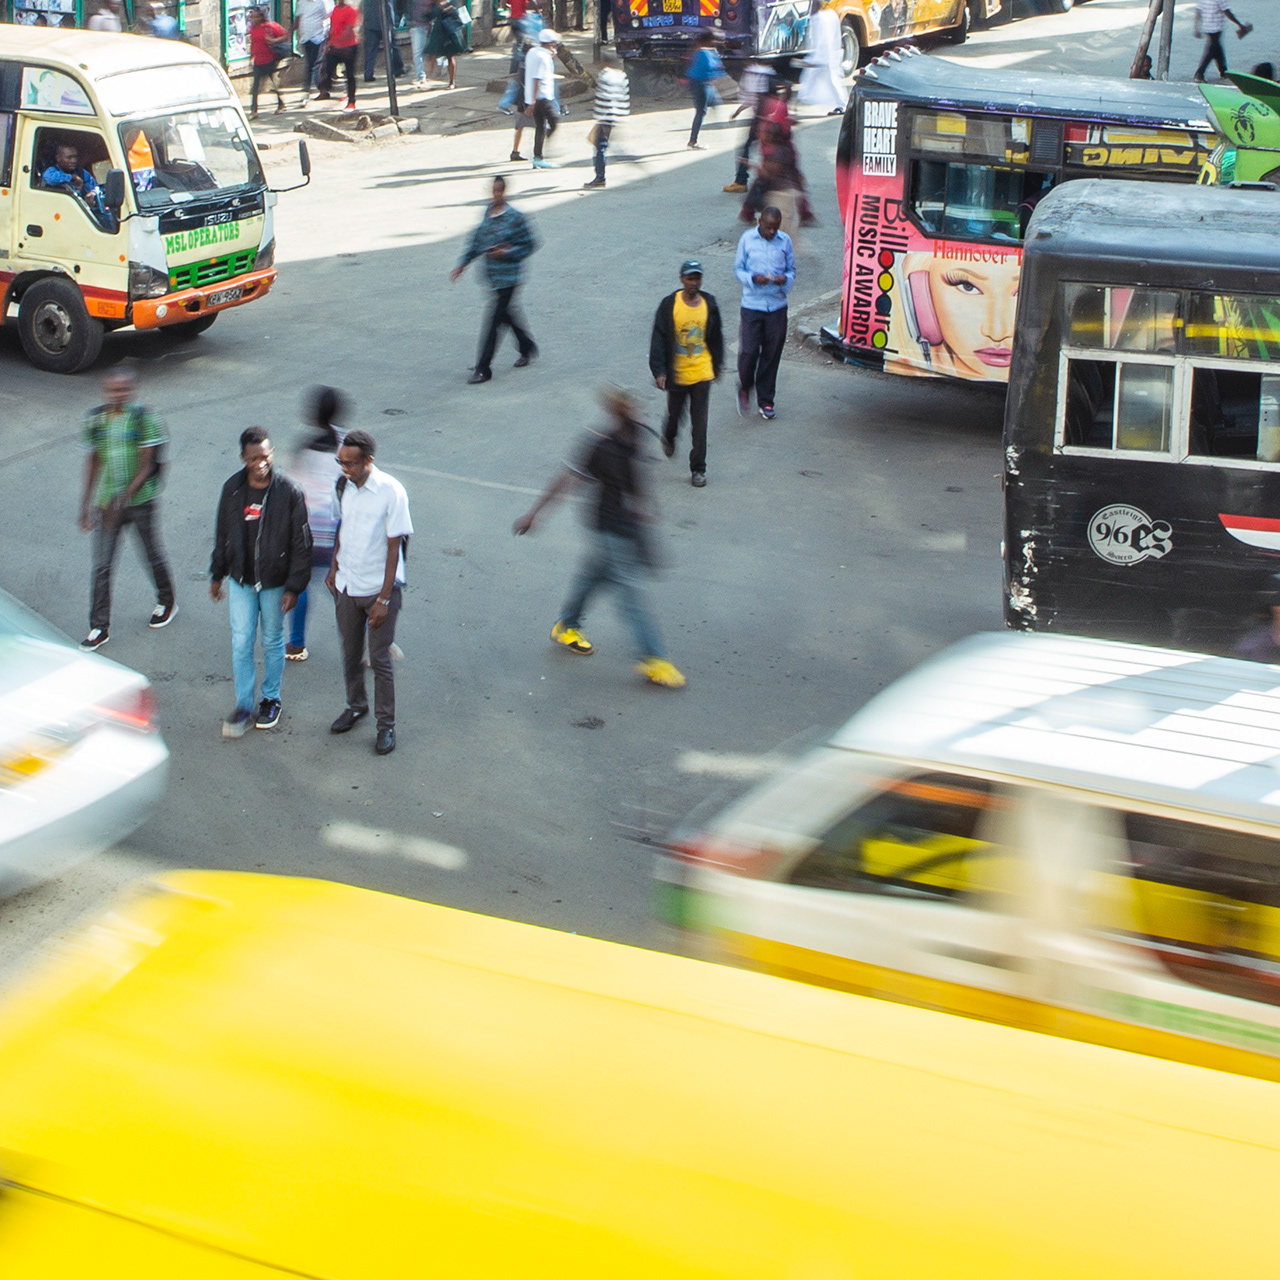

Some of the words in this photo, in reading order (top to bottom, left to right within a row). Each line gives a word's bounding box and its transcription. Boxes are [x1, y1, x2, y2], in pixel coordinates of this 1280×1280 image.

[864, 101, 898, 128] BRAVE
[864, 128, 897, 154] HEART
[863, 155, 896, 175] FAMILY
[204, 212, 233, 226] ISUZU
[856, 195, 881, 258] MUSIC
[165, 234, 187, 255] MSL
[188, 222, 239, 250] OPERATORS
[849, 264, 875, 346] AWARDS
[1102, 509, 1143, 524] Eastleigh
